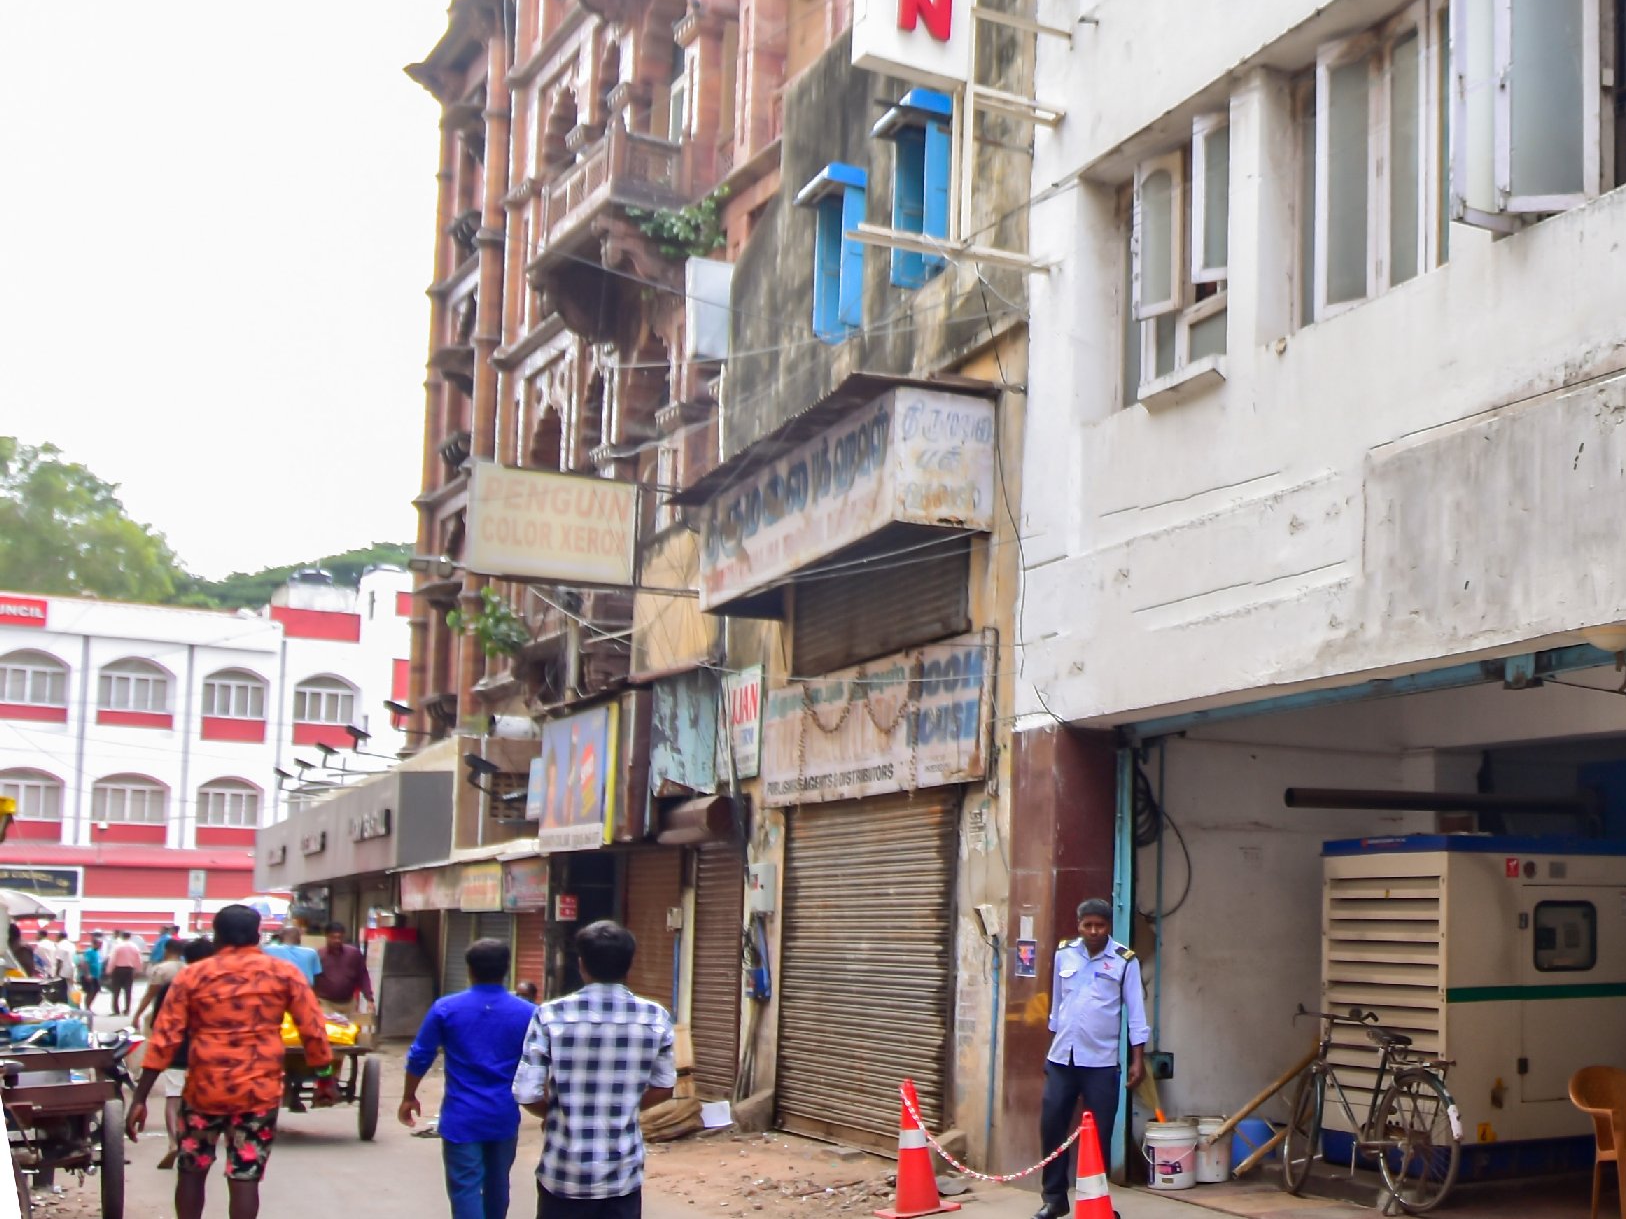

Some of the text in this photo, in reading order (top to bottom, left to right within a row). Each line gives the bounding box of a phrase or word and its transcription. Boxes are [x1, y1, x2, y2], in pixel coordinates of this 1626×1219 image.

[483, 476, 632, 523] PENGUIN
[482, 515, 627, 556] COLOR XEROX
